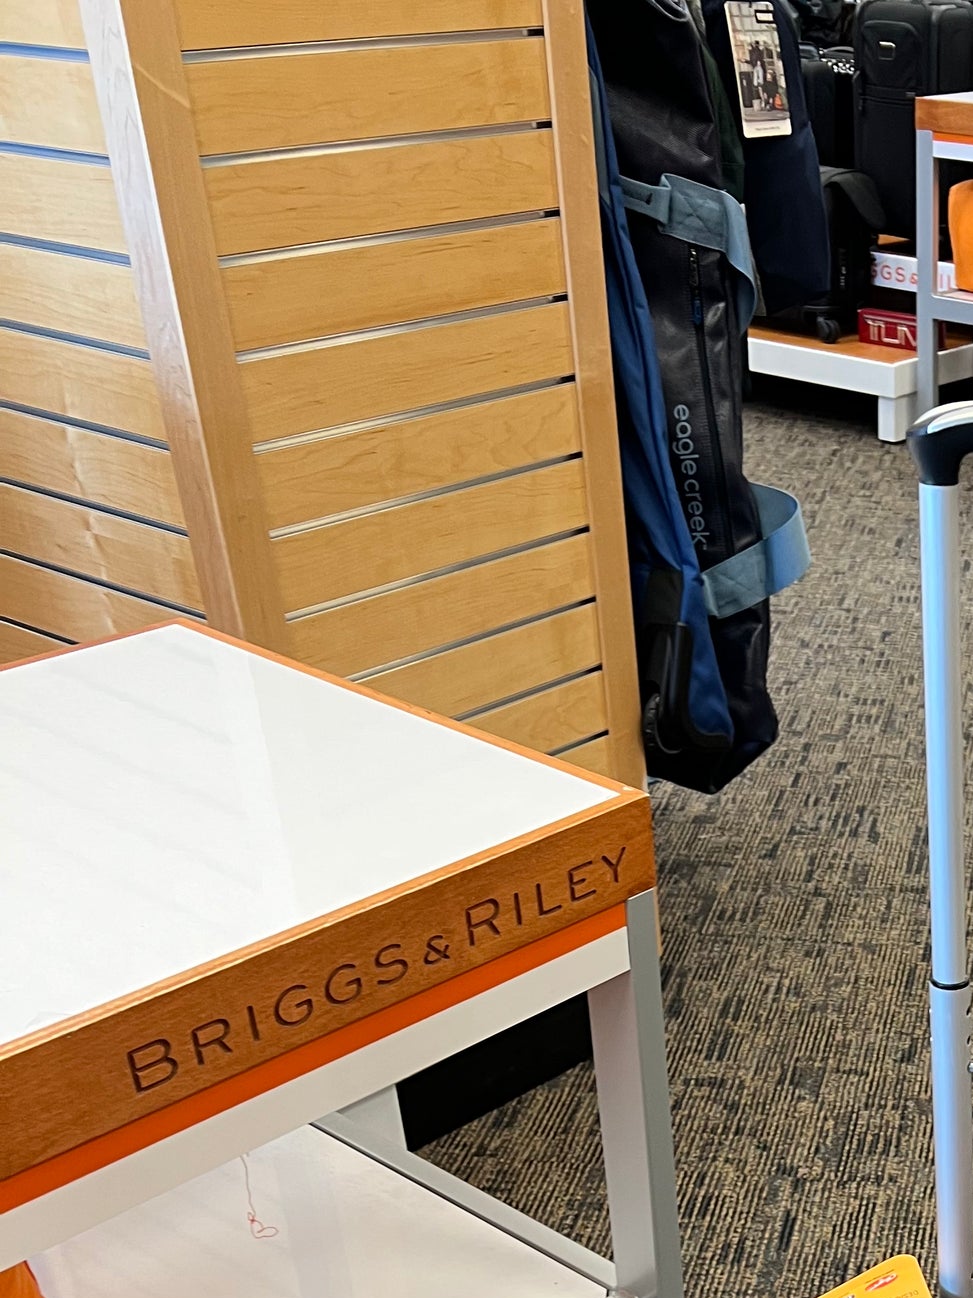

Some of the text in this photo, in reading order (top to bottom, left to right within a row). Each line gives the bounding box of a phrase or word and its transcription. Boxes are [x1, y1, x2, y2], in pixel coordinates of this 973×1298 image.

[672, 404, 710, 550] eagle creek
[127, 846, 627, 1094] BRIGGS & RILEY
